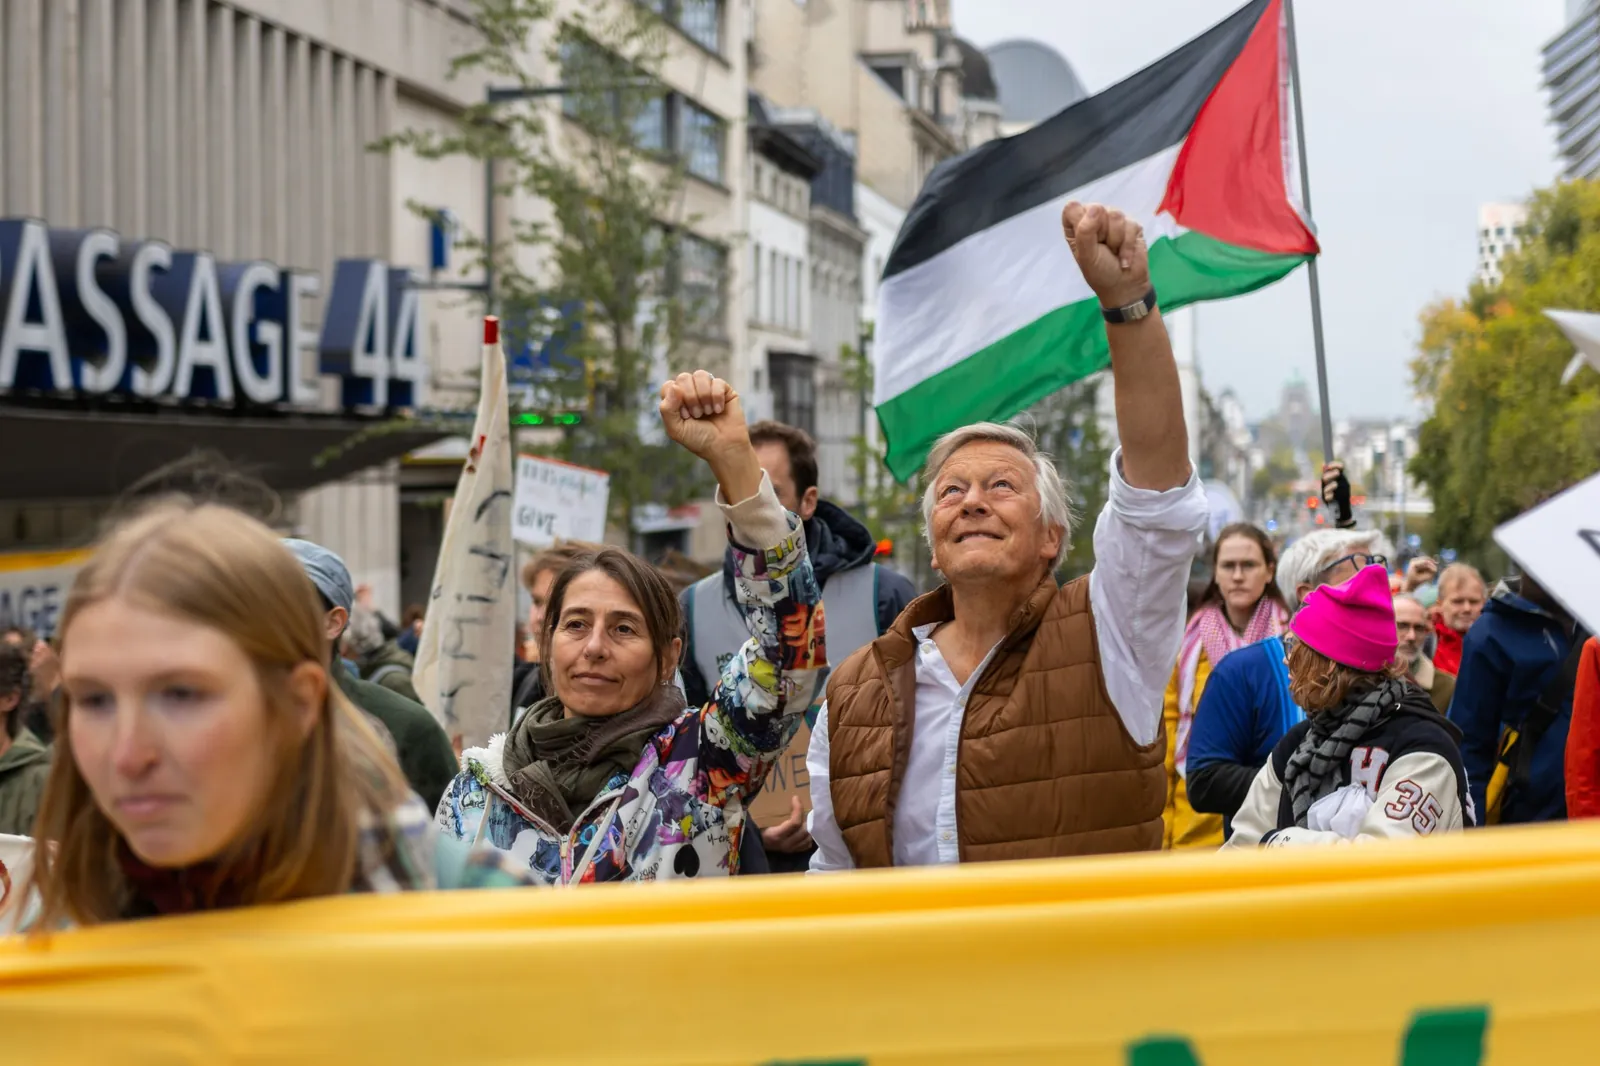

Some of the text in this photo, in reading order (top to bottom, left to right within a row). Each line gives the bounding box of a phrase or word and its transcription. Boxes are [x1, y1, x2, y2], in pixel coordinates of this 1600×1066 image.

[0, 216, 425, 407] ASSAGE 44
[517, 506, 557, 536] GIVE
[1350, 746, 1389, 802] H
[1384, 779, 1443, 837] 35
